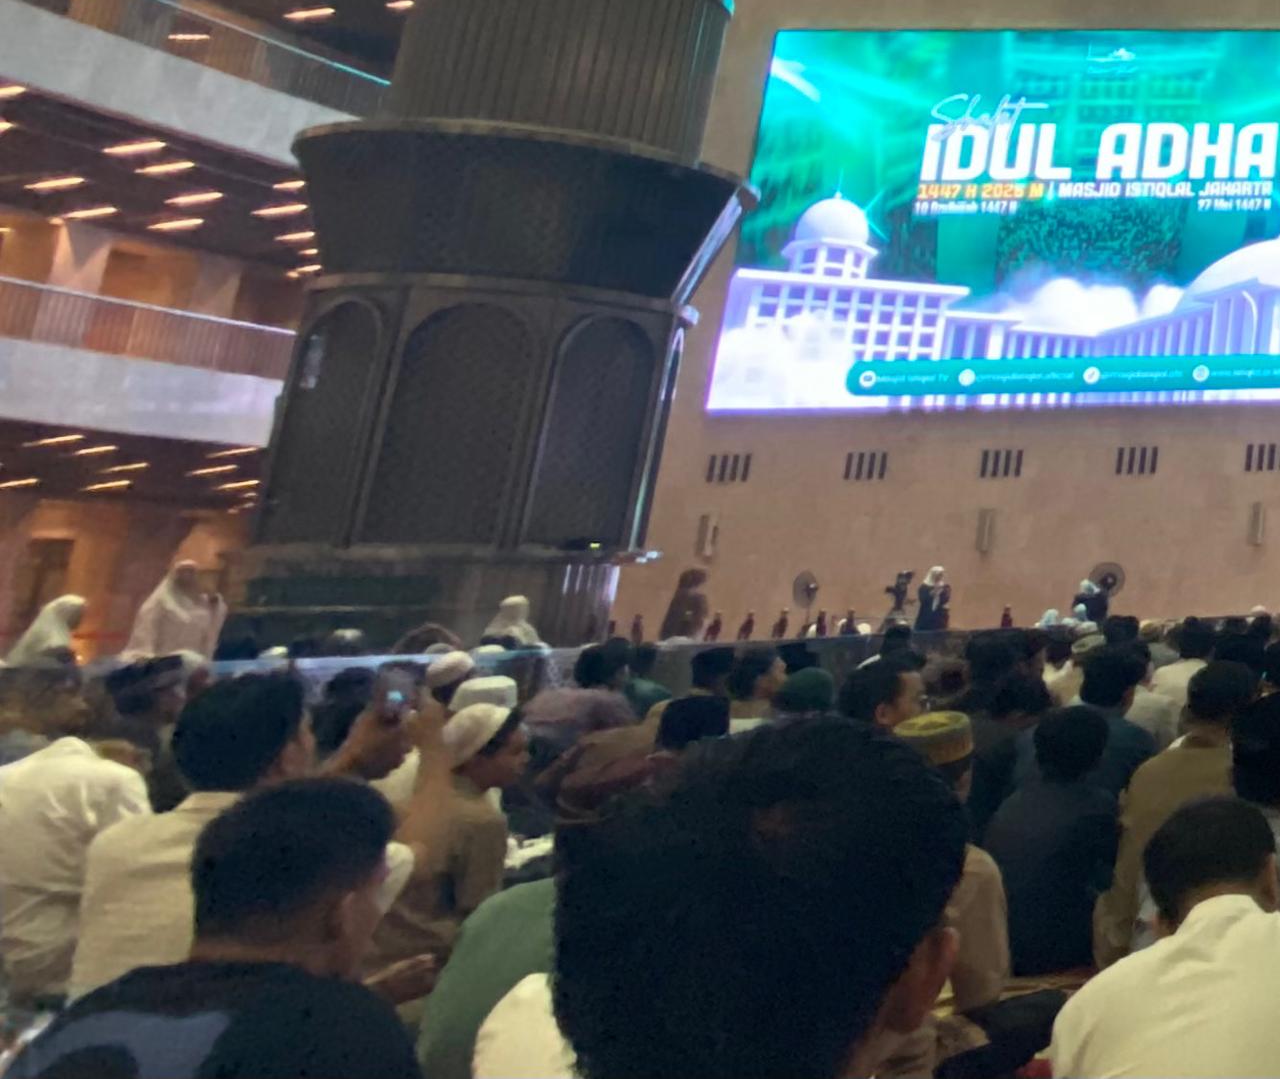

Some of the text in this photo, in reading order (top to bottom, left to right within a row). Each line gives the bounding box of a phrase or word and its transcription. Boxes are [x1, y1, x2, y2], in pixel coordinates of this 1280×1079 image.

[920, 122, 1279, 181] IDUL ADHA
[917, 183, 961, 200] 1447
[1058, 181, 1121, 199] MASJID
[1125, 181, 1195, 198] ISTIQLAL
